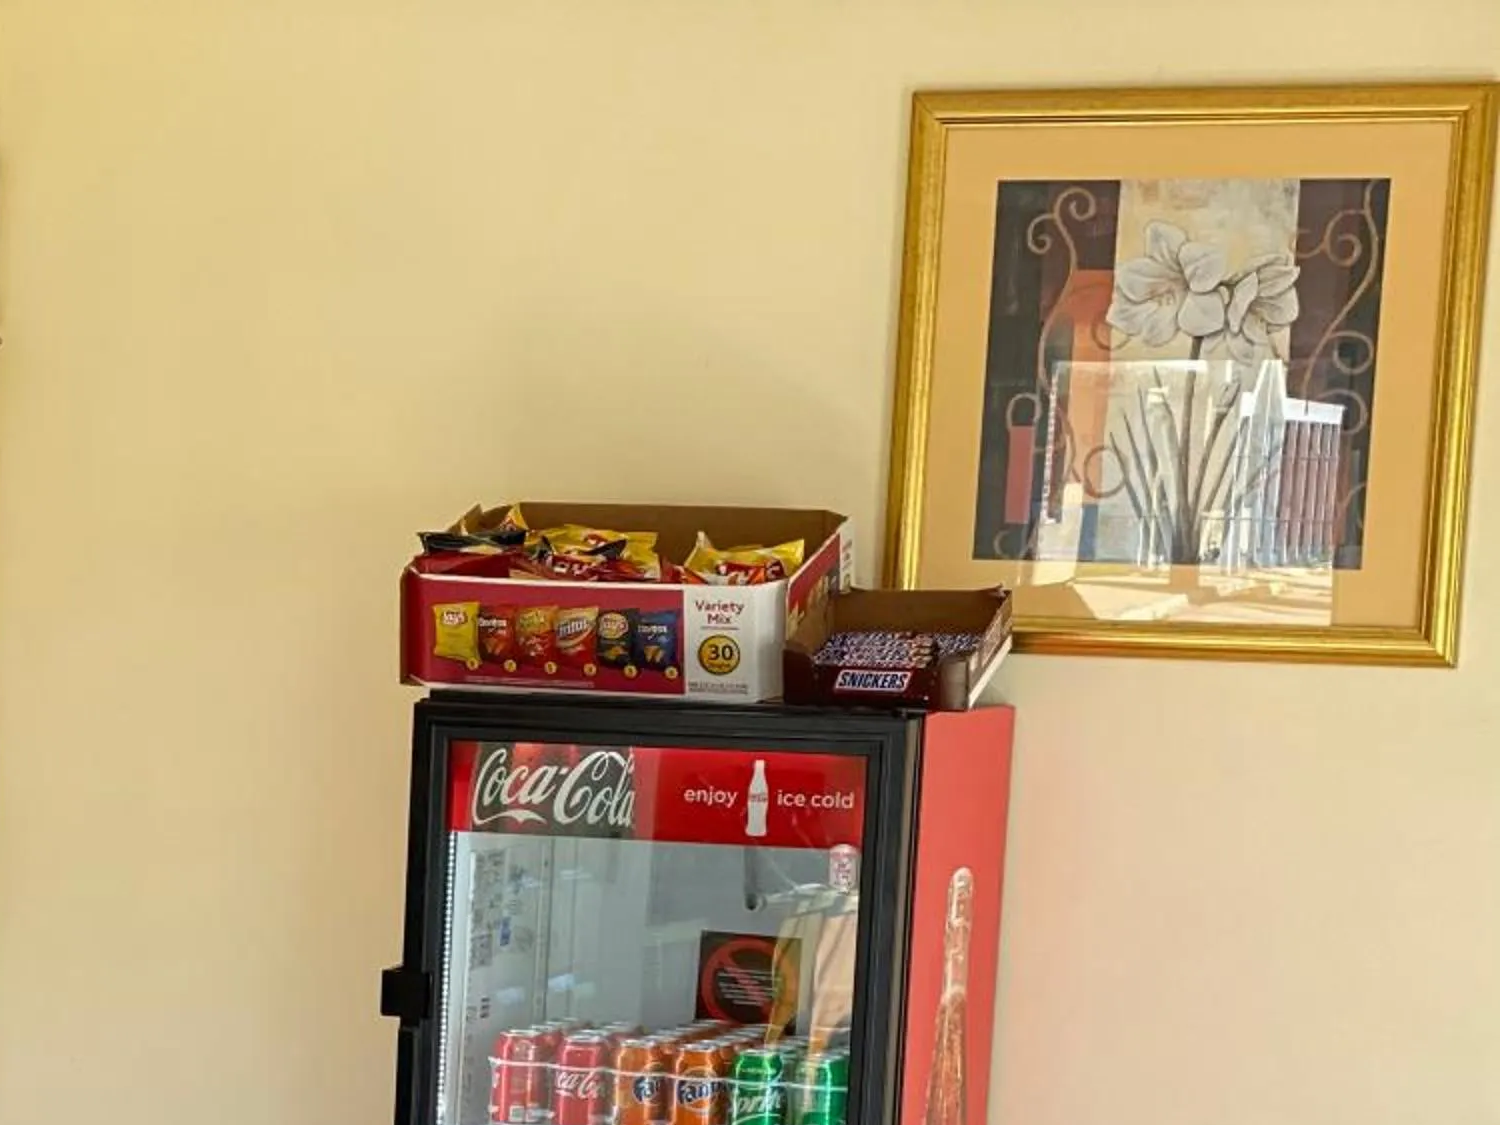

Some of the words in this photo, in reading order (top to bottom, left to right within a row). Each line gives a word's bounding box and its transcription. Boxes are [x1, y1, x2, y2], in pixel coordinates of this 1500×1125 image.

[695, 600, 745, 615] Variety
[707, 613, 731, 625] Mix
[707, 644, 733, 661] 30
[837, 672, 907, 689] SNICKERS
[471, 748, 636, 828] Coca-Cola
[683, 785, 738, 808] enjoy
[776, 789, 806, 807] ice
[810, 791, 855, 809] cold
